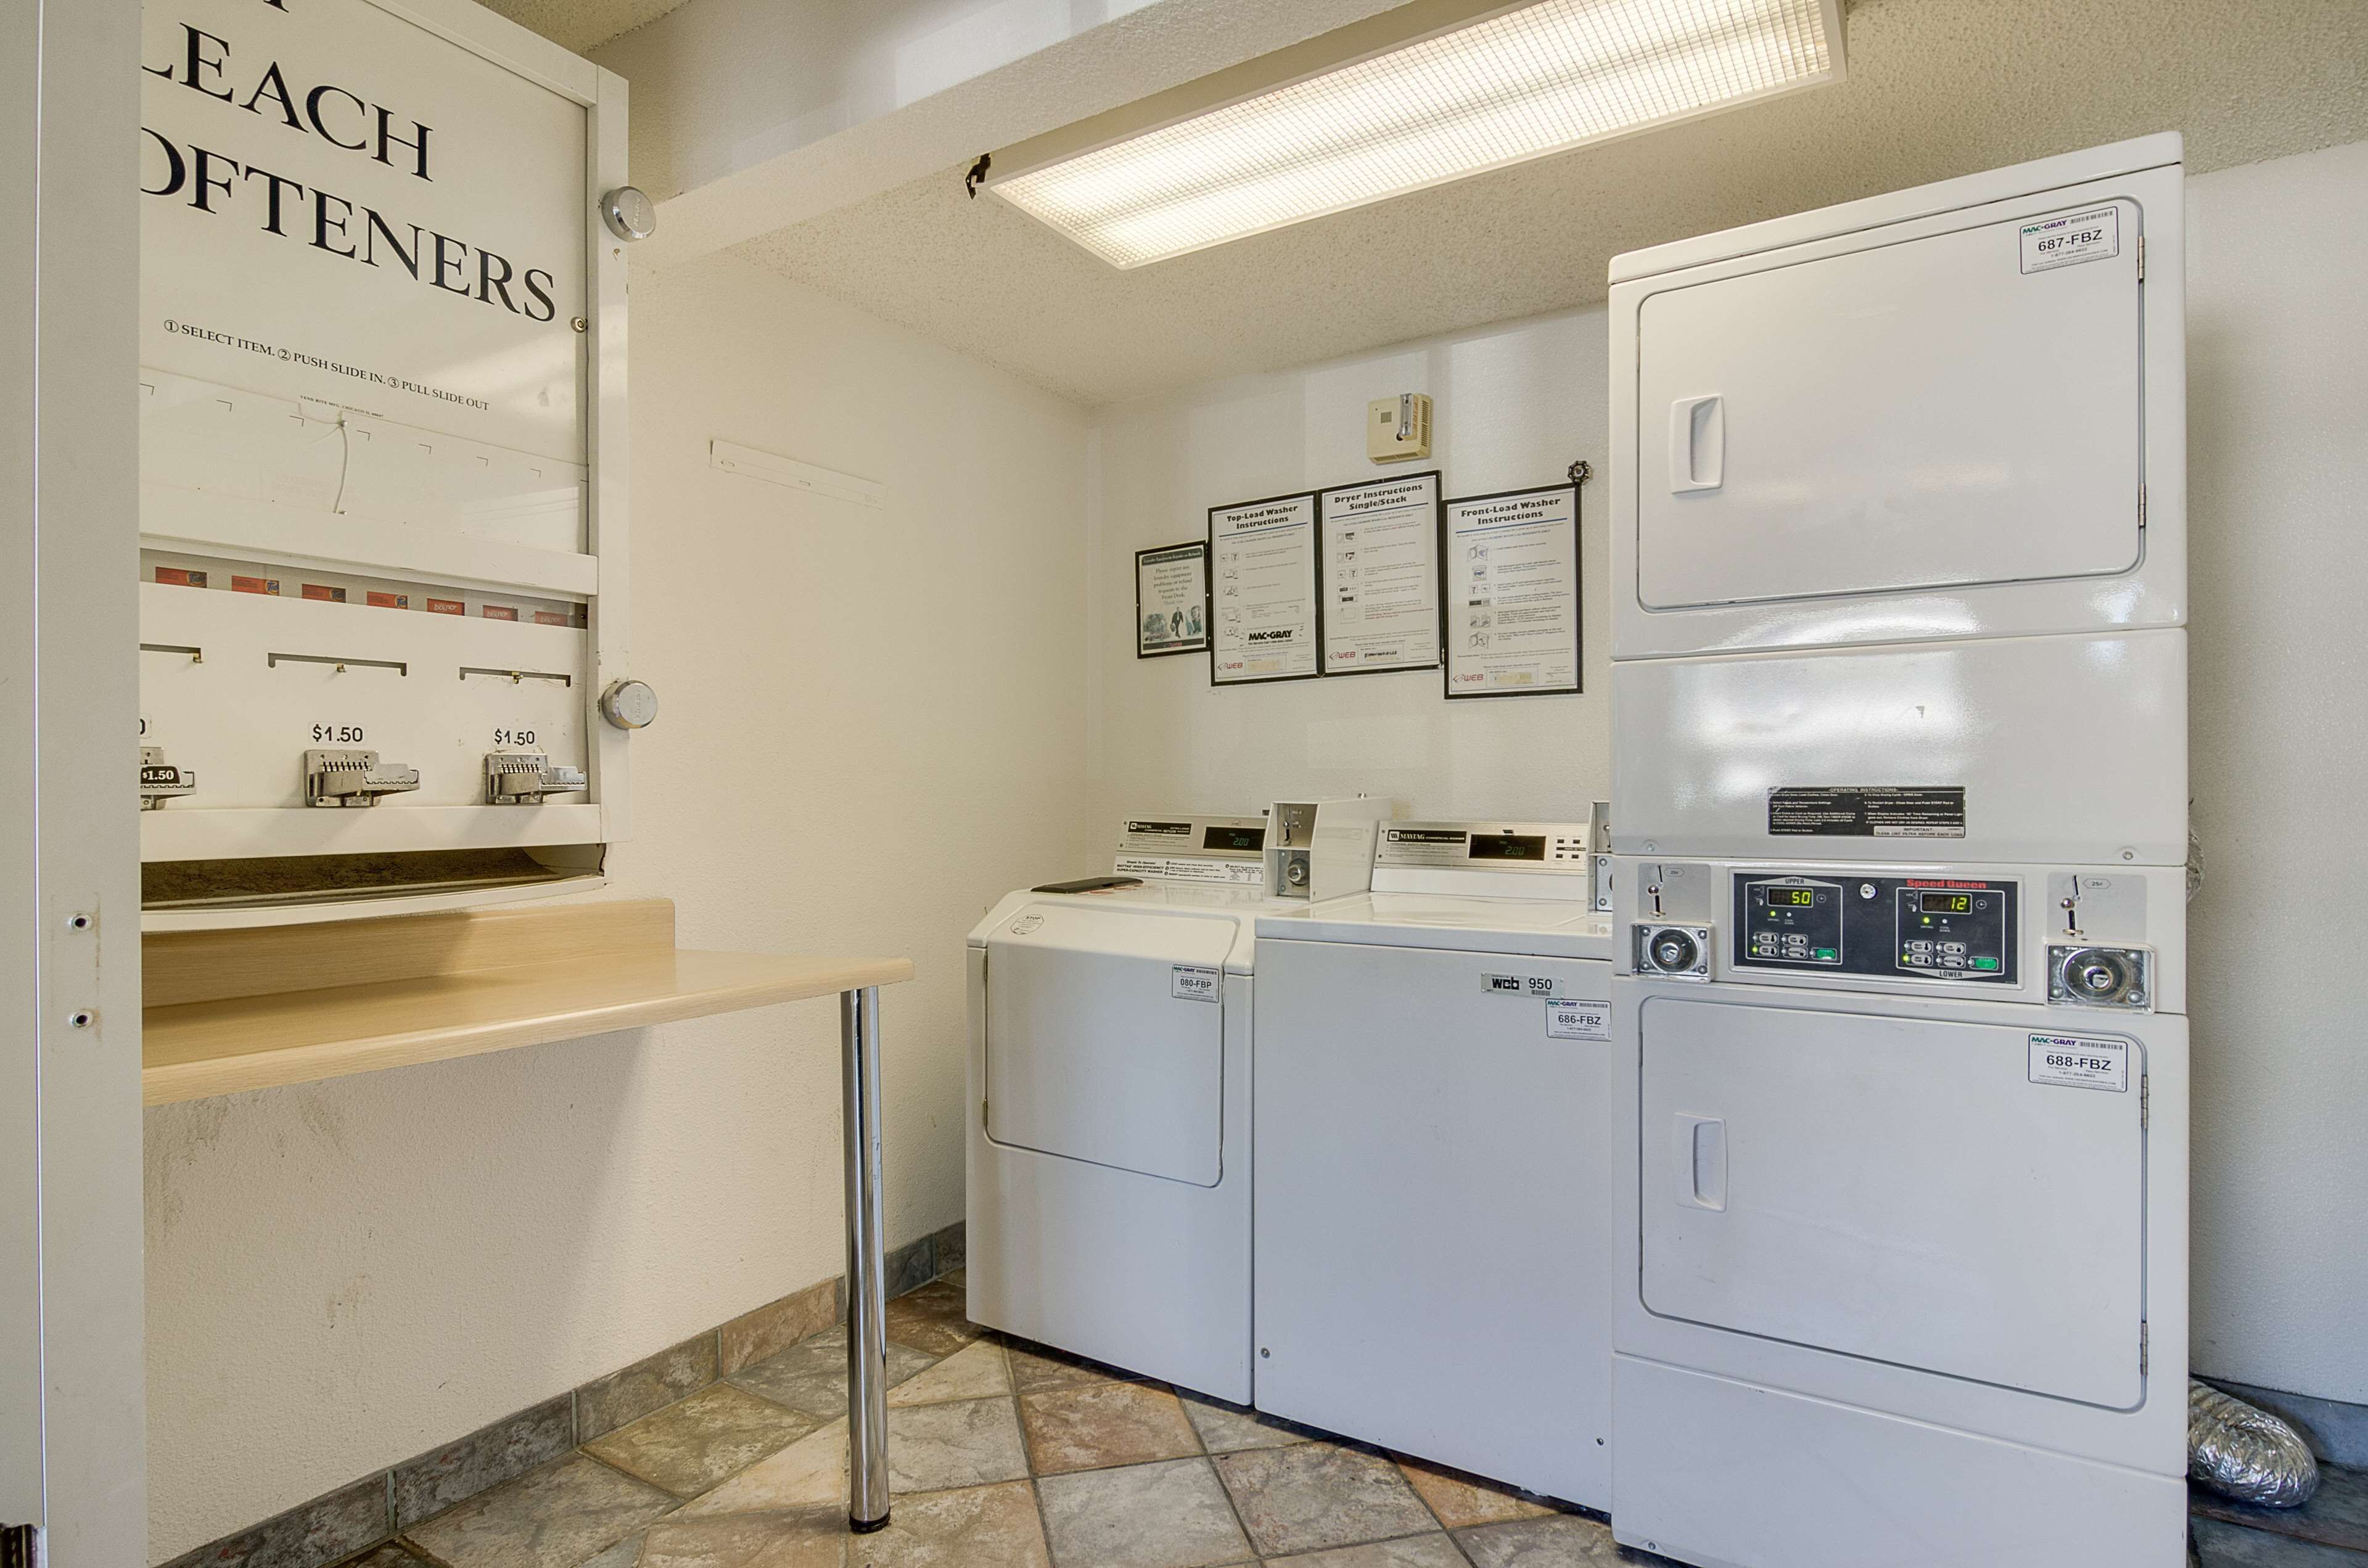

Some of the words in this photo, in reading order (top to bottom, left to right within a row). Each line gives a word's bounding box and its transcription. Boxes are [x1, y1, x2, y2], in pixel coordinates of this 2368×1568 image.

[142, 23, 434, 182] EACH
[2038, 229, 2102, 251] 687-FBZ
[181, 324, 234, 345] SELECT
[238, 339, 275, 356] ITEM.
[294, 353, 328, 369] PUSH
[331, 363, 367, 379] SLIDE
[369, 372, 386, 384] IN.
[401, 380, 430, 396] PULL
[432, 389, 464, 404] SLIDE
[466, 398, 489, 411] OUT
[1334, 494, 1361, 503] Dryer
[1364, 485, 1423, 499] Instructions
[1349, 496, 1407, 510] Single/Stack
[1461, 504, 1517, 517] Front-Load
[1520, 498, 1561, 509] Washer
[1227, 511, 1264, 522] Top-Load
[1265, 506, 1297, 515] Washer
[1478, 511, 1543, 525] Instructions
[1236, 516, 1288, 529] Instructions
[312, 724, 363, 742] $1.50
[495, 728, 535, 745] $1.50
[142, 770, 174, 780] $1.50
[1233, 838, 1249, 846] 2.00
[1505, 846, 1524, 855] 2.00
[1906, 879, 1944, 888] Speed
[1947, 879, 1987, 889] Queen
[1792, 892, 1811, 904] 50
[1951, 897, 1967, 910] 12
[1180, 979, 1212, 988] 080-FBP
[1492, 977, 1519, 990] web
[1529, 978, 1552, 990] 950
[1558, 1014, 1601, 1025] 686-FBZ
[2046, 1054, 2111, 1070] 688-FBZ
